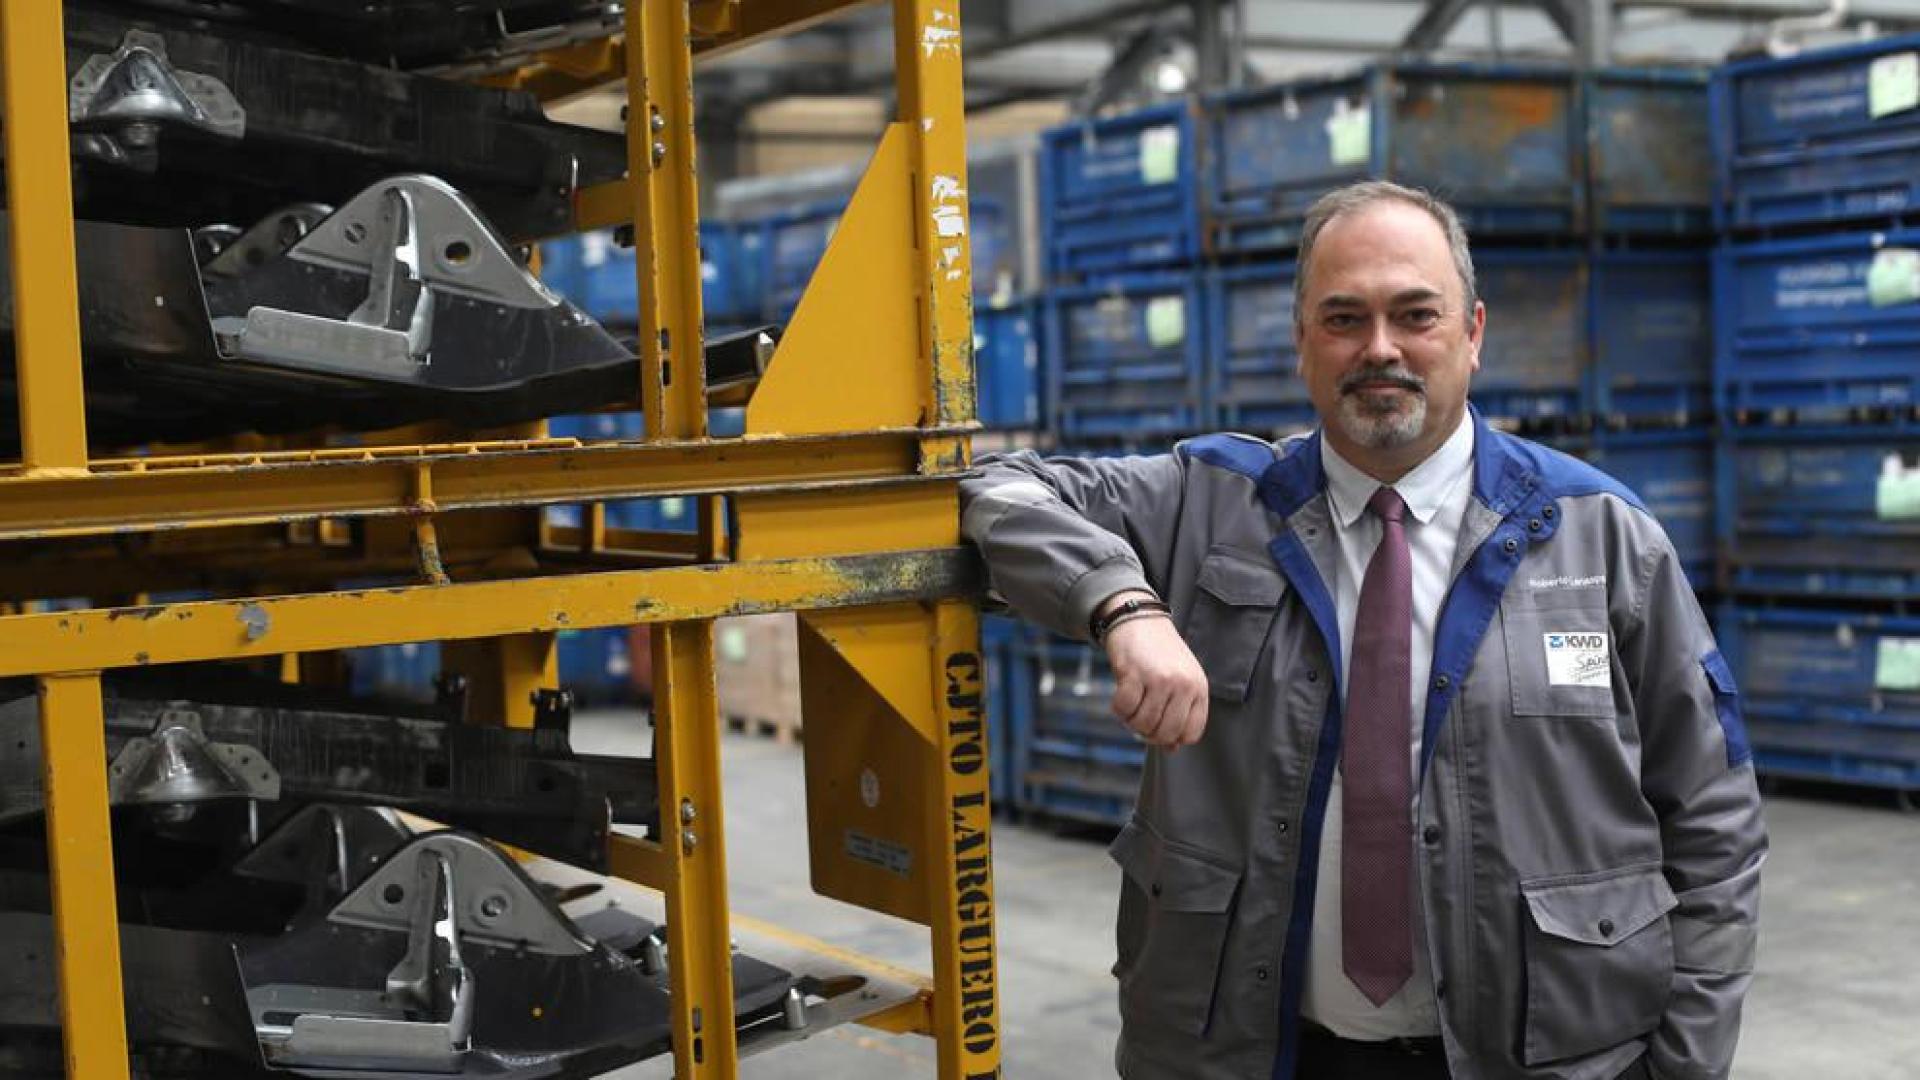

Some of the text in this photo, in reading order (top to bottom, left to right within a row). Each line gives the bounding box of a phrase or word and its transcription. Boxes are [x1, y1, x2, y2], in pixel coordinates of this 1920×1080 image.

[1565, 635, 1602, 649] KWD
[946, 651, 984, 775] CJTO
[953, 791, 996, 1055] LARGUERO
